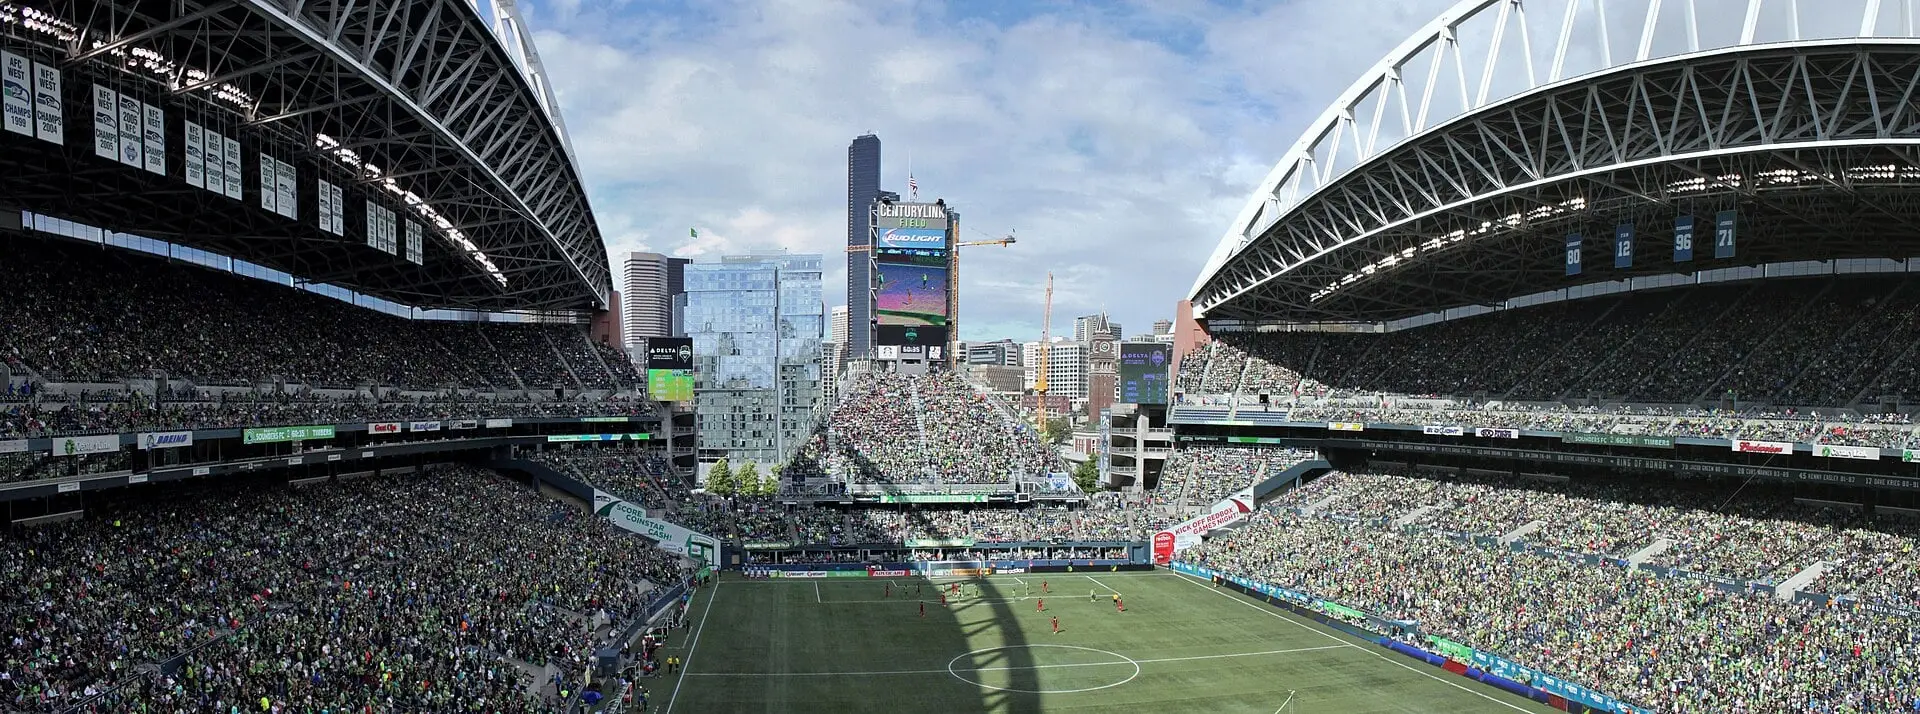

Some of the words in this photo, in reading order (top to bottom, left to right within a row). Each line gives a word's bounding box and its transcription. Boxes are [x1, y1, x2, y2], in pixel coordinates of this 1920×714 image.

[10, 57, 22, 70] AFC
[8, 66, 25, 81] WEST
[40, 68, 54, 82] NFC
[39, 77, 56, 92] WEST
[99, 89, 111, 102] NFC
[5, 102, 31, 119] CHAMPS
[97, 98, 113, 111] WEST
[37, 110, 62, 127] CHAMPS
[123, 111, 137, 125] 2005
[149, 108, 159, 120] NFC
[11, 115, 27, 128] 1999
[42, 121, 58, 134] 2004
[125, 122, 136, 134] NFC
[147, 116, 161, 129] WEST
[96, 128, 117, 144] CHAMPS
[189, 125, 199, 136] NFC
[100, 139, 114, 151] 2005
[187, 133, 200, 145] WEST
[209, 133, 218, 144] NFC
[145, 145, 164, 160] CHAMPS
[208, 141, 220, 152] WEST
[228, 142, 237, 152] NFC
[227, 150, 239, 161] WEST
[187, 159, 203, 173] CHAMPS
[207, 167, 223, 180] CHAMPS
[226, 174, 241, 187] CHAMPS
[880, 203, 945, 219] CENTURYLINK
[899, 219, 927, 229] FIELD
[887, 233, 910, 242] BUD
[911, 234, 943, 243] LIGHT
[1675, 233, 1692, 251] 96
[1718, 228, 1733, 247] 71
[1617, 240, 1631, 257] 12
[1567, 248, 1580, 265] 80
[156, 434, 188, 445] BOEING
[256, 432, 279, 440] SOUNDERS
[279, 431, 285, 439] FC
[312, 429, 332, 437] TIMBERS
[1644, 438, 1670, 446] TIMBERS
[1739, 442, 1783, 454] Budweiser
[1616, 458, 1631, 467] RING
[1634, 459, 1642, 467] OF
[1645, 460, 1667, 470] HONOR
[1799, 472, 1807, 480] 45
[1823, 474, 1839, 482] EASLEY
[1886, 479, 1900, 487] KRIEG
[617, 503, 643, 518] SCORE
[626, 514, 665, 531] COINSTAR
[1174, 523, 1192, 535] KICK
[1192, 518, 1206, 528] OFF
[1206, 507, 1234, 522] REDBOX
[1193, 521, 1217, 535] GAMES
[1217, 511, 1240, 526] NIGHT!
[648, 528, 673, 541] CASH!
